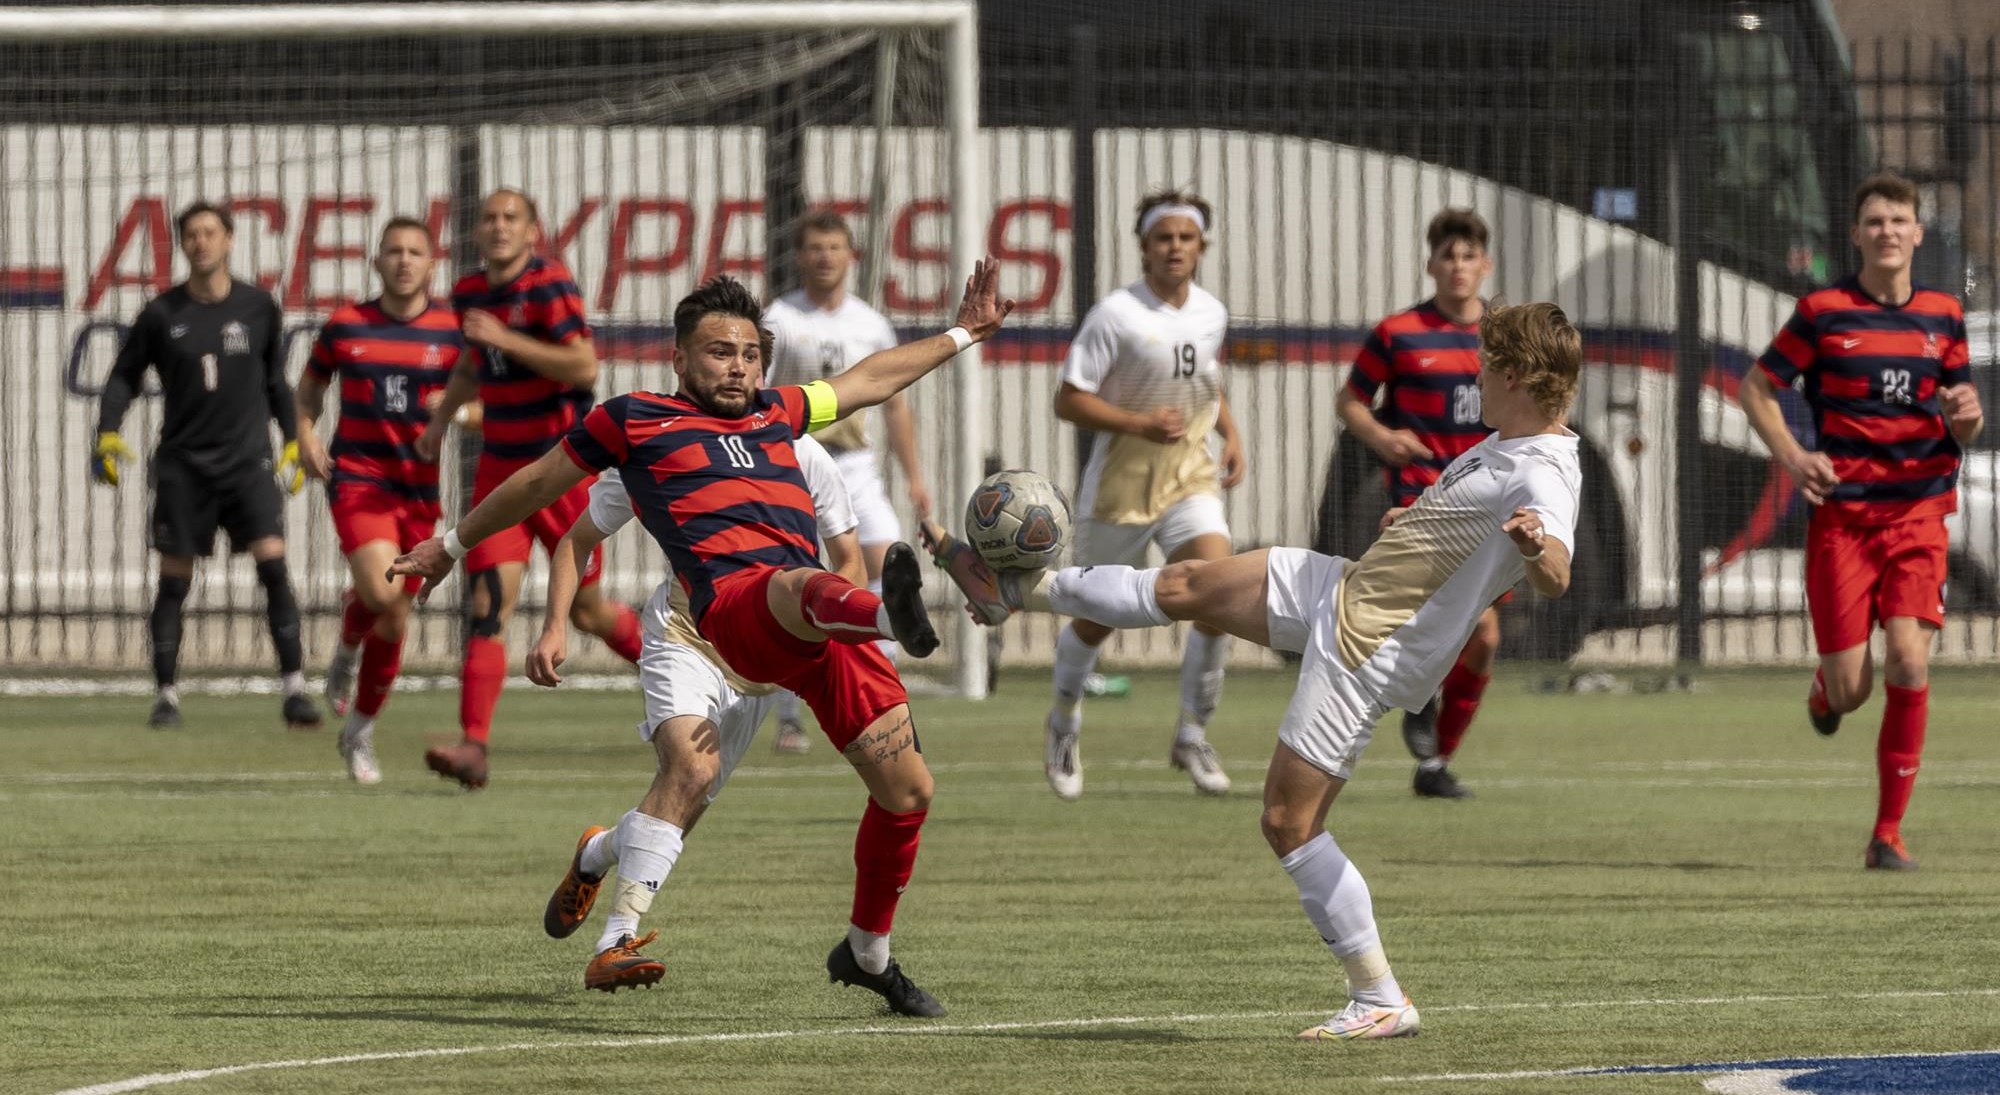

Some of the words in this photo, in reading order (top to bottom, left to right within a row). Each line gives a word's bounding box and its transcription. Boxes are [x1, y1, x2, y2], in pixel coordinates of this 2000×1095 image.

[201, 353, 218, 392] 1
[1173, 343, 1196, 379] 19
[1453, 384, 1481, 424] 20
[717, 434, 755, 469] 10
